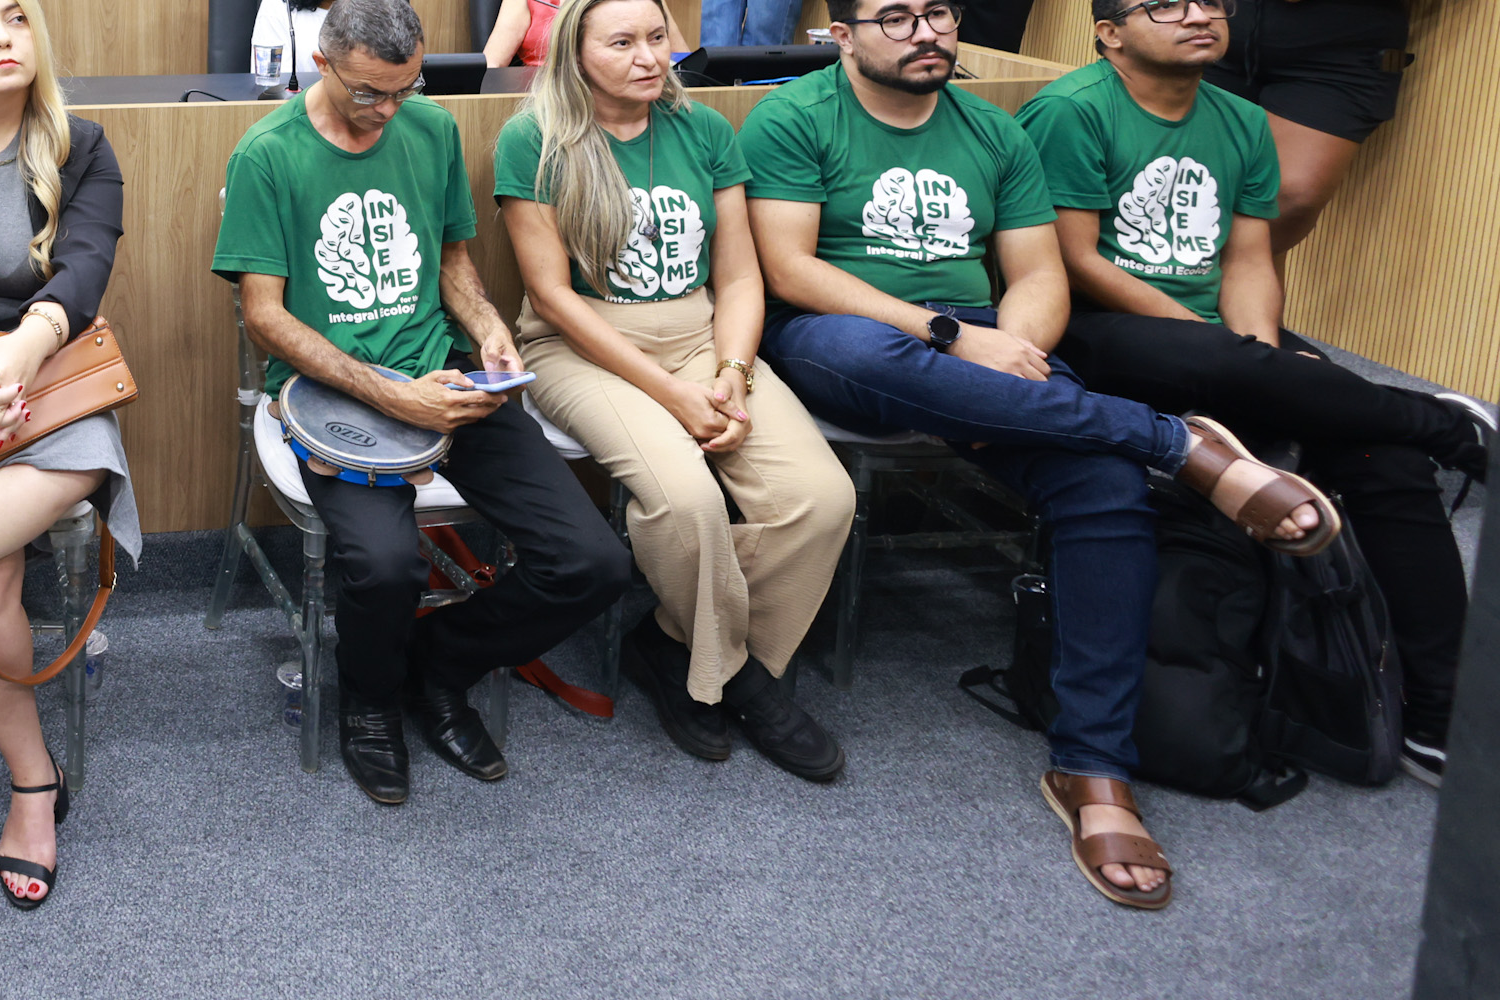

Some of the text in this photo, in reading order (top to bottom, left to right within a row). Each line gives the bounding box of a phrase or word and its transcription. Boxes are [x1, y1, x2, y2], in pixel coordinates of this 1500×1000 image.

[1177, 168, 1204, 186] IN
[922, 180, 952, 197] IN
[658, 194, 686, 213] IN
[1176, 190, 1198, 207] SI
[368, 199, 394, 219] IN
[926, 202, 950, 219] SI
[663, 217, 685, 236] SI
[1176, 212, 1189, 229] E
[373, 223, 394, 242] SI
[666, 241, 680, 259] E
[866, 245, 923, 261] Integral
[1176, 235, 1211, 252] ME
[377, 248, 390, 267] E
[1114, 255, 1173, 275] Integral
[380, 267, 413, 291] ME
[667, 260, 695, 282] ME
[328, 303, 416, 324] Integral Ecolog
[330, 424, 374, 445] IZZO
